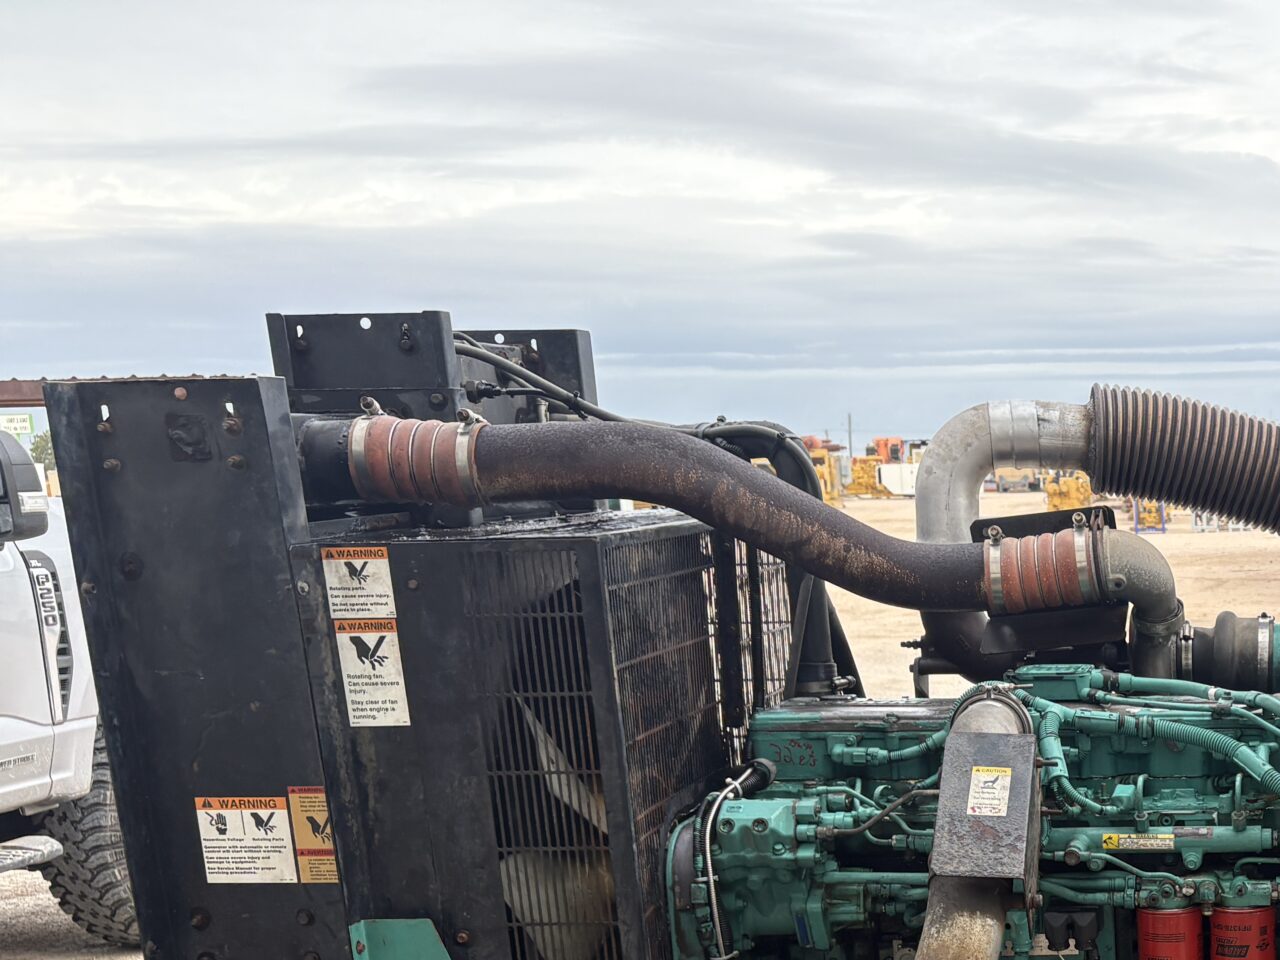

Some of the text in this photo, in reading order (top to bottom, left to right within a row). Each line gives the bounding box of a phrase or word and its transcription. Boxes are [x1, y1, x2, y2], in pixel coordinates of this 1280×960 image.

[336, 549, 384, 558] WARNING
[36, 574, 58, 627] F250
[347, 622, 394, 631] WARNING
[217, 799, 277, 809] WARNING
[1218, 945, 1248, 957] BALDWIN
